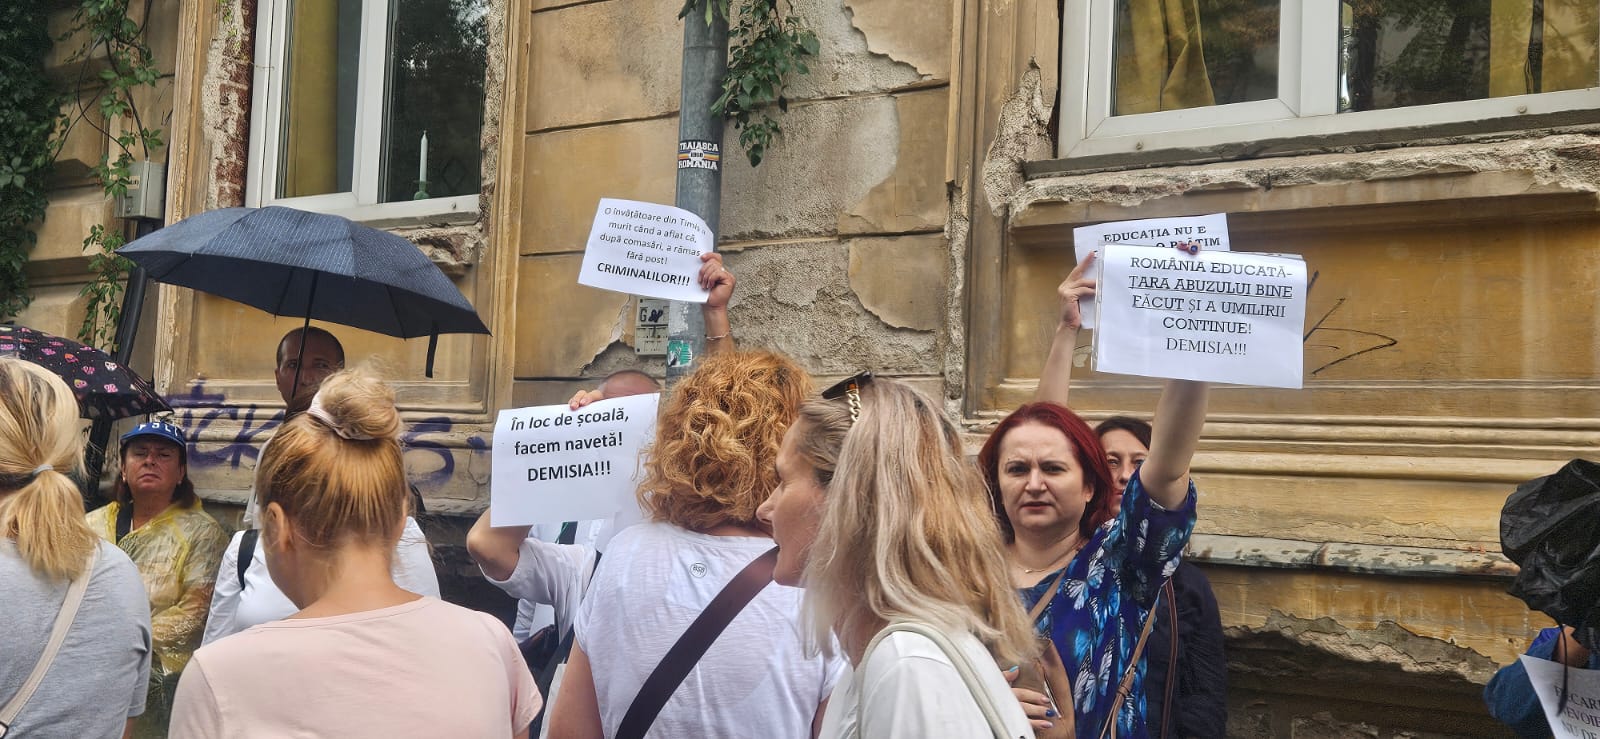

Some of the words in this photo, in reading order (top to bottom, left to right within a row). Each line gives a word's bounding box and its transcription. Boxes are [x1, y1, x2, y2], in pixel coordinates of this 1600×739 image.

[678, 160, 718, 170] ROMANIA
[604, 207, 612, 215] O
[613, 208, 662, 222] învățătoare
[664, 214, 676, 224] din
[608, 222, 632, 232] murit
[634, 224, 655, 235] când
[664, 229, 684, 240] aflat
[685, 234, 696, 243] că,
[1104, 228, 1170, 242] EDUCAȚIA
[1174, 226, 1193, 235] NU
[1198, 226, 1206, 234] E
[600, 232, 622, 244] după
[624, 238, 664, 250] comasări,
[674, 245, 700, 256] rămas
[626, 250, 644, 261] fără
[646, 254, 668, 265] post!
[1130, 257, 1206, 273] ROMÂNIA
[1210, 262, 1293, 278] EDUCATĂ-
[597, 262, 690, 286] CRIMINALILOR!!!
[1174, 278, 1252, 296] ABUZULUI
[1256, 286, 1293, 298] BINE
[1132, 294, 1184, 310] FĂCUT
[1188, 299, 1201, 313] ȘI
[1204, 301, 1216, 312] A
[1221, 303, 1286, 318] UMILIRII
[1162, 316, 1252, 334] CONTINUE!
[1166, 337, 1246, 356] DEMISIA!!!
[510, 416, 524, 431] În
[529, 416, 550, 429] loc
[554, 412, 572, 426] de
[577, 408, 629, 427] școală,
[514, 441, 560, 456] facem
[566, 432, 622, 450] navetă!
[528, 460, 611, 482] DEMISIA!!!
